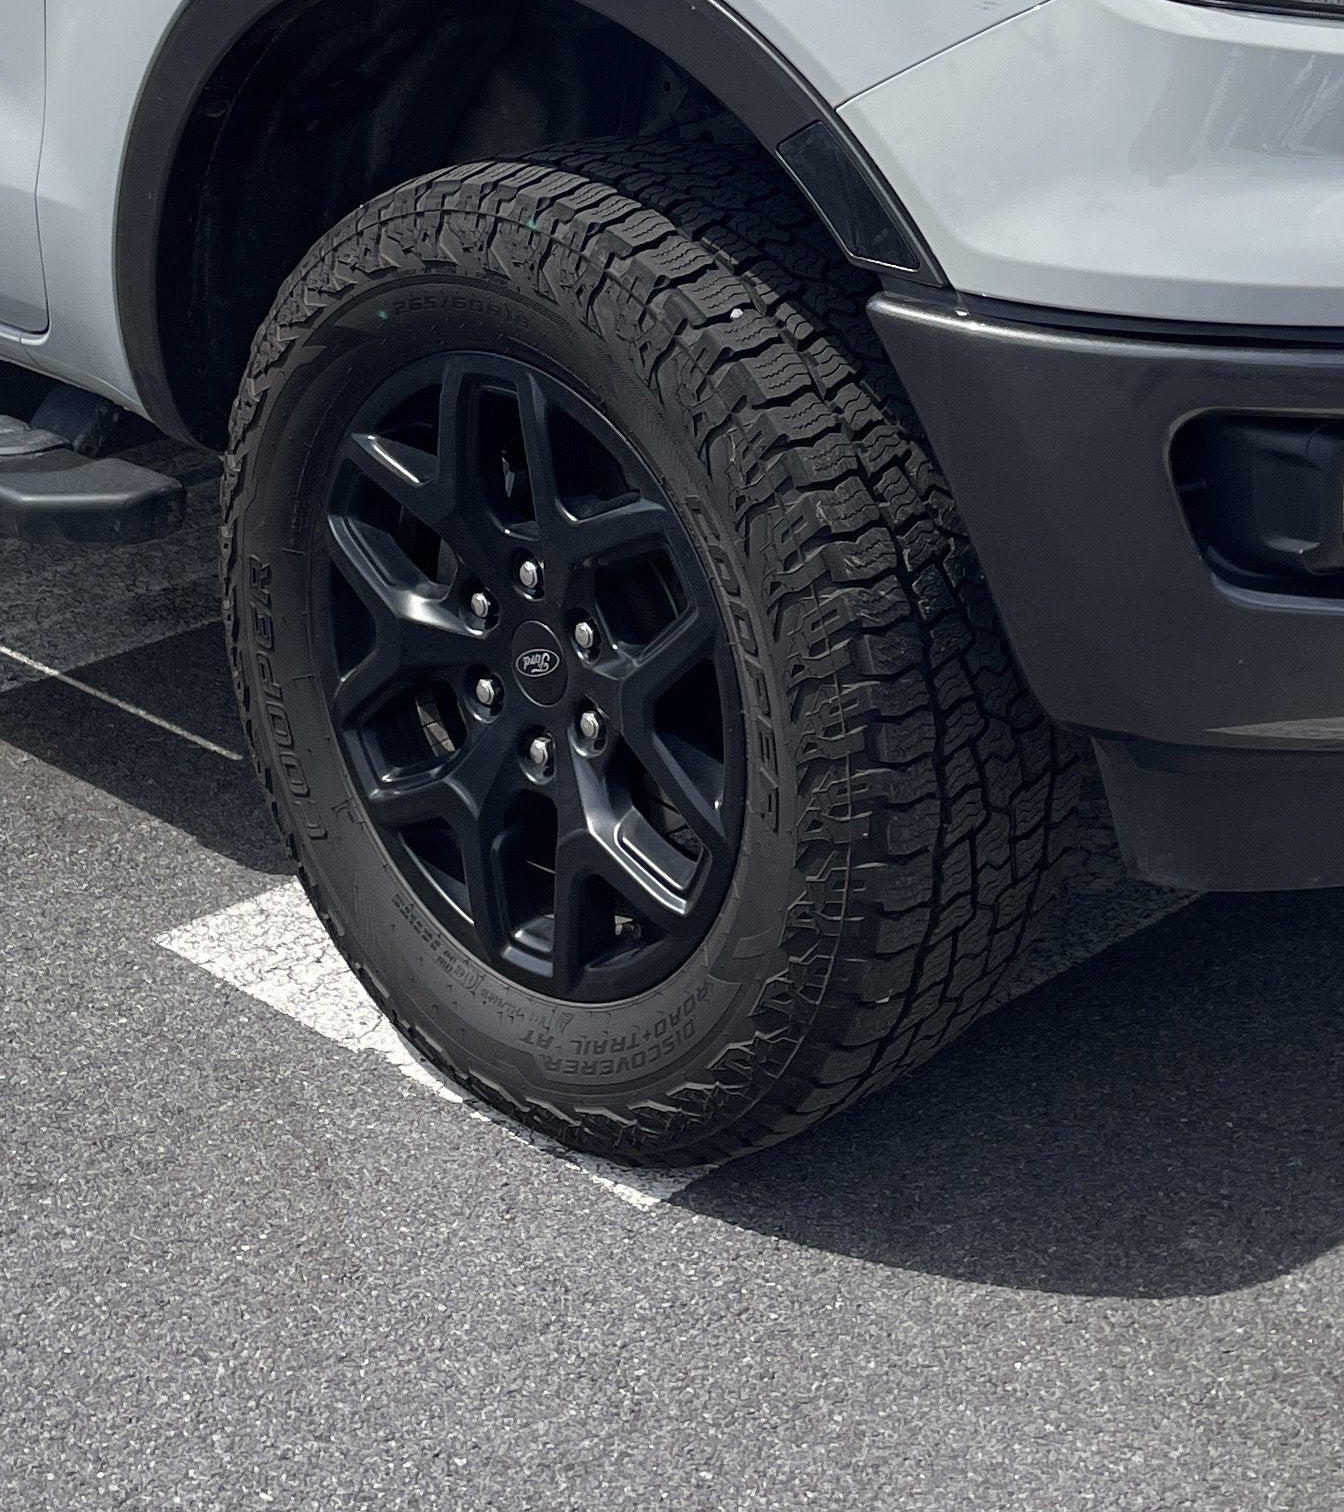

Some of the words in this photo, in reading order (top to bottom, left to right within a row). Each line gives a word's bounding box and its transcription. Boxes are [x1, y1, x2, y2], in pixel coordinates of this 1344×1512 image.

[249, 554, 329, 840] COOPER
[522, 652, 551, 674] Ford
[684, 494, 779, 835] COOPER
[542, 1018, 696, 1076] DISCOVERER
